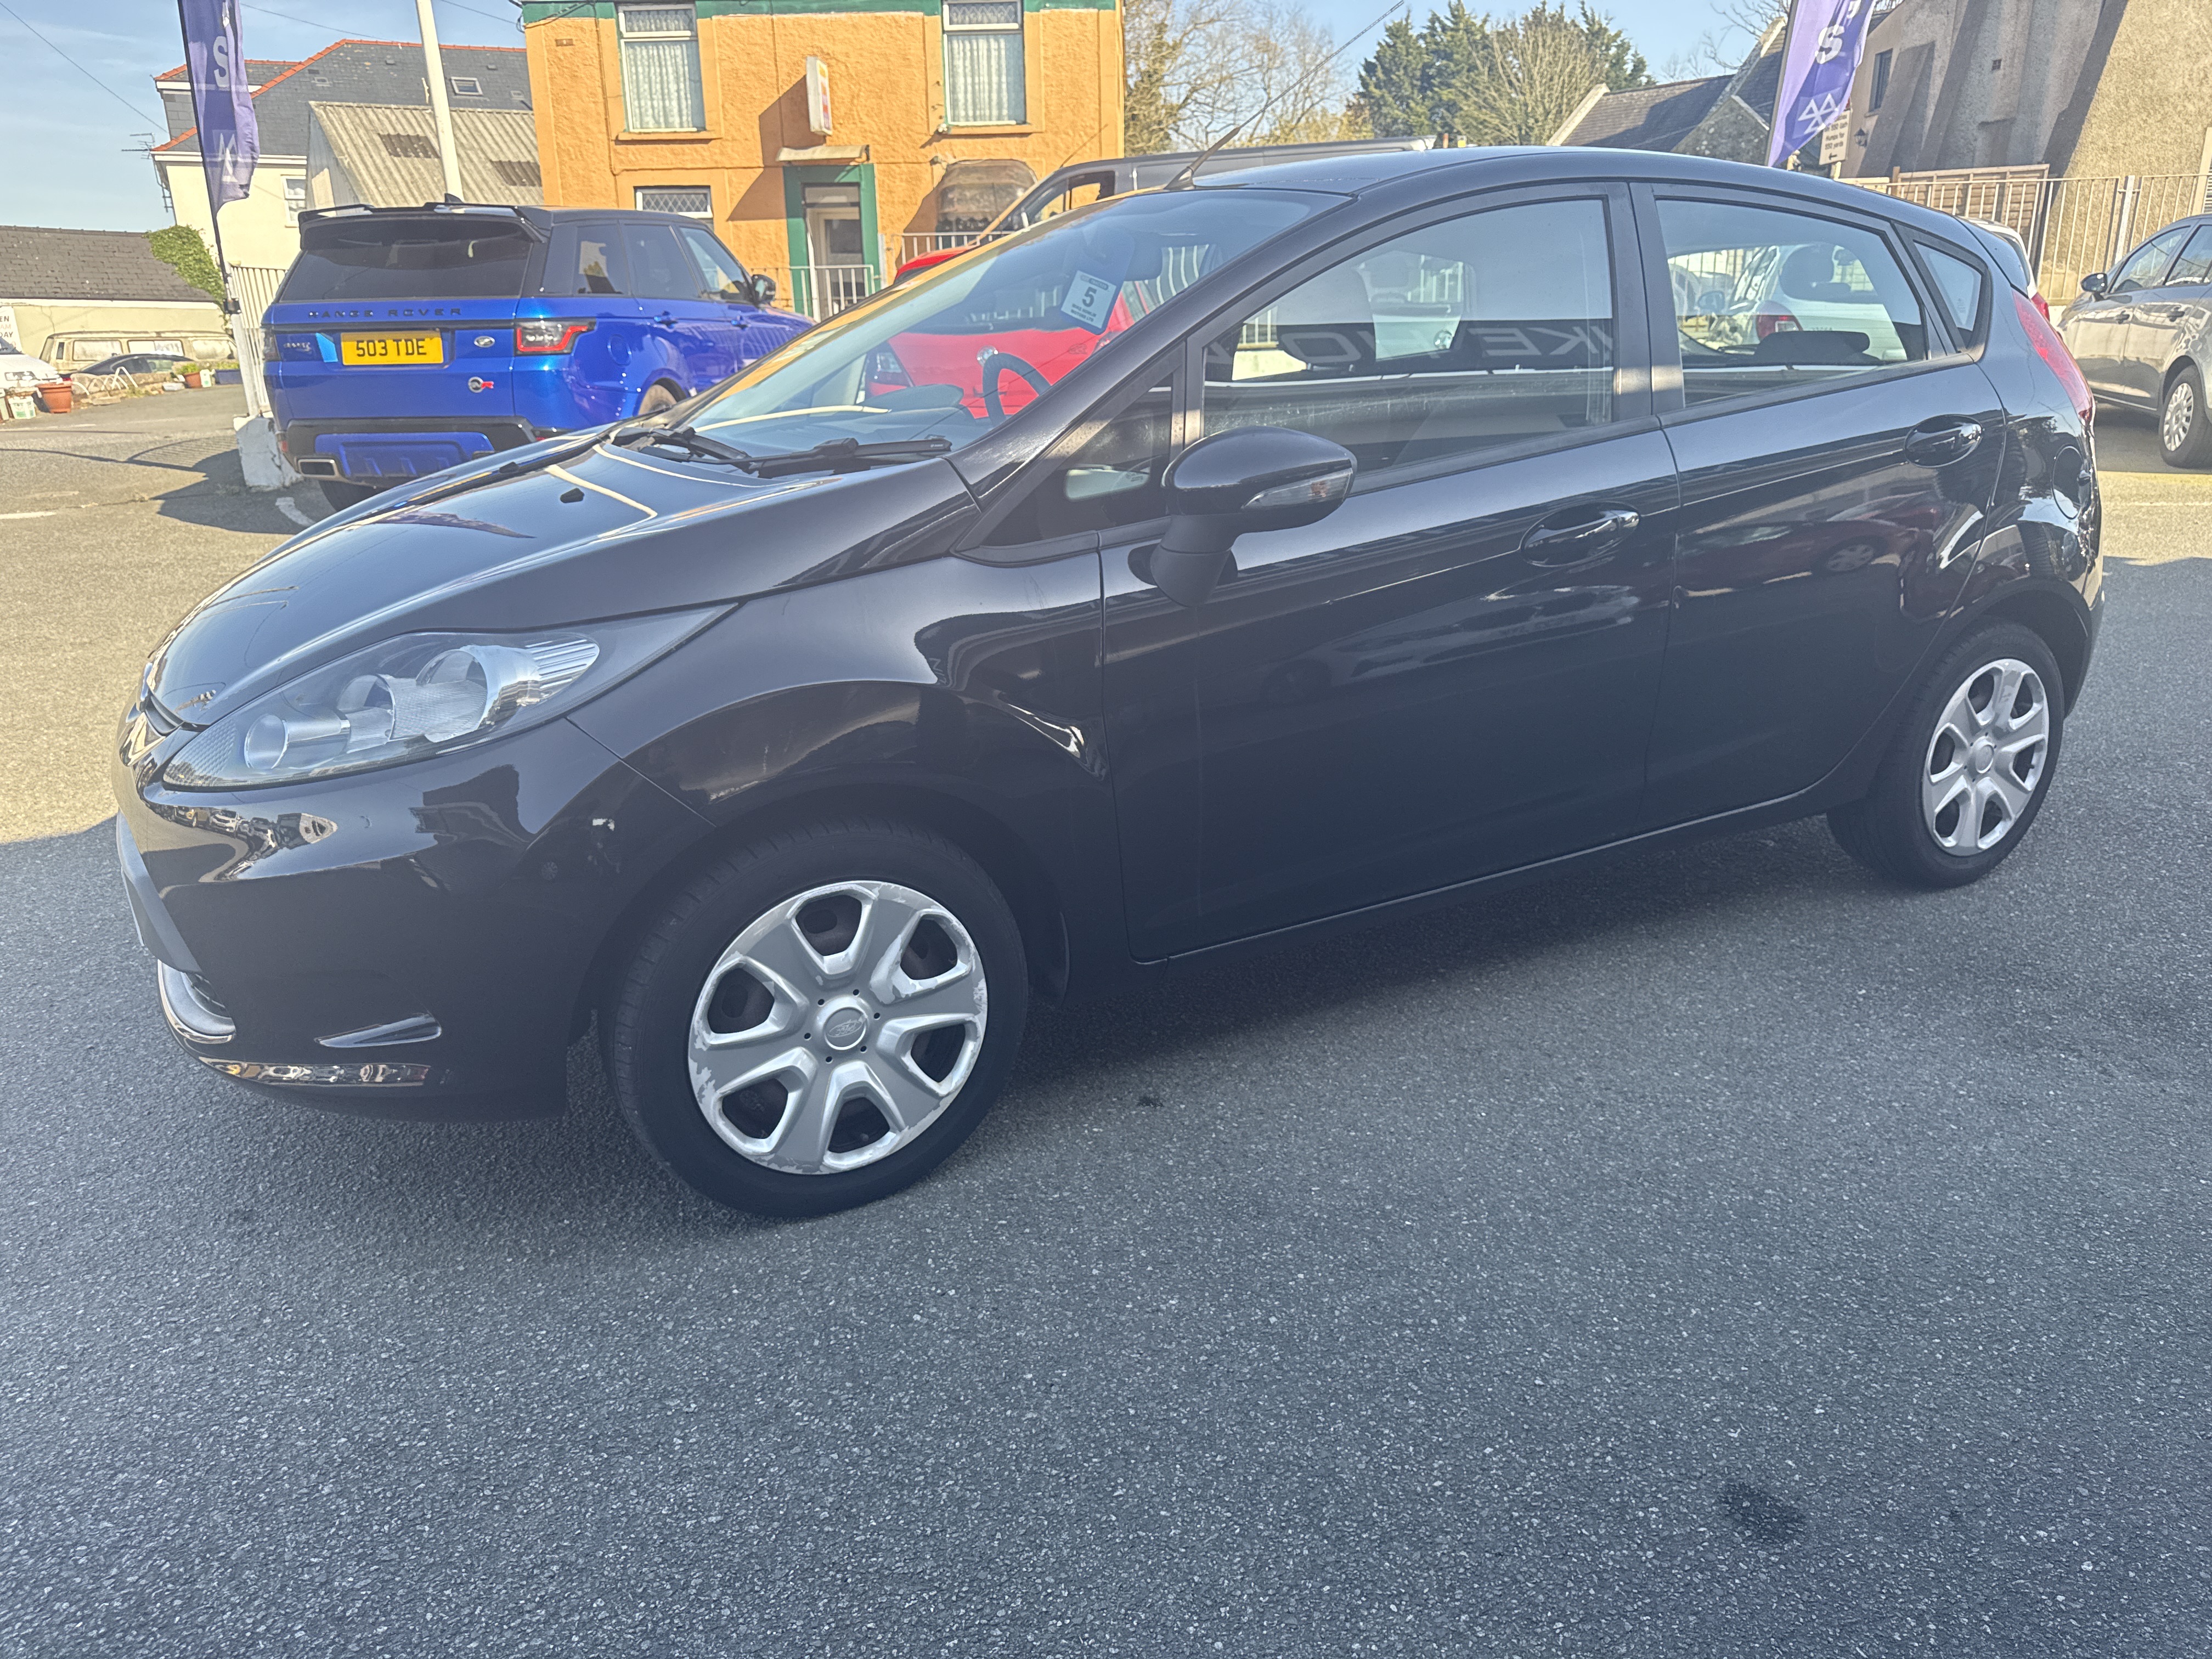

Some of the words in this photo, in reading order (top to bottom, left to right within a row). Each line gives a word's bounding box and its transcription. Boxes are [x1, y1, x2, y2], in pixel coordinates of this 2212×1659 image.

[1082, 286, 1097, 307] 5
[388, 308, 461, 317] ROVER
[357, 340, 388, 357] 503
[393, 338, 427, 356] TDE
